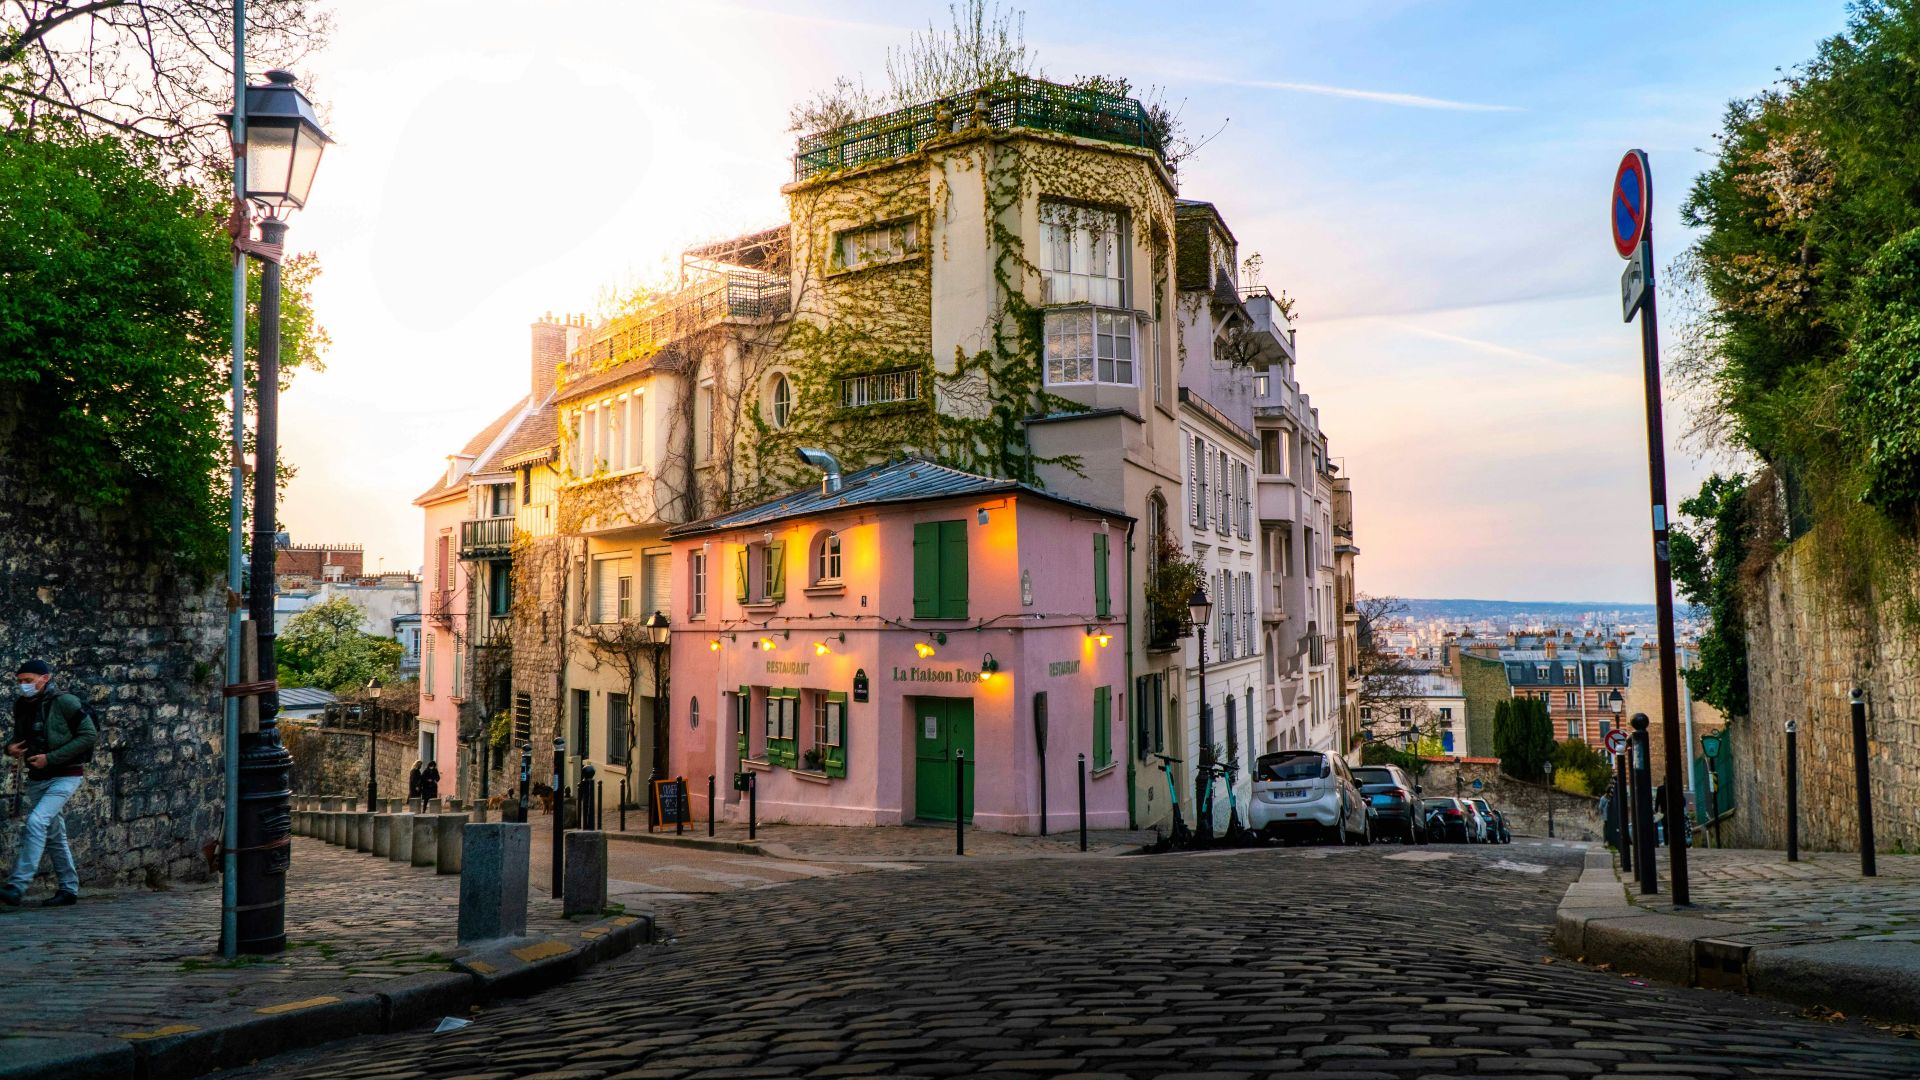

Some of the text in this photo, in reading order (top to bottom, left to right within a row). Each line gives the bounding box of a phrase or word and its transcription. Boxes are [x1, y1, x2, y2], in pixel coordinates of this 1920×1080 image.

[766, 661, 810, 675] RESTAURANT
[893, 667, 907, 681] La
[910, 667, 953, 682] Maison
[1049, 660, 1080, 677] RESTAURANT
